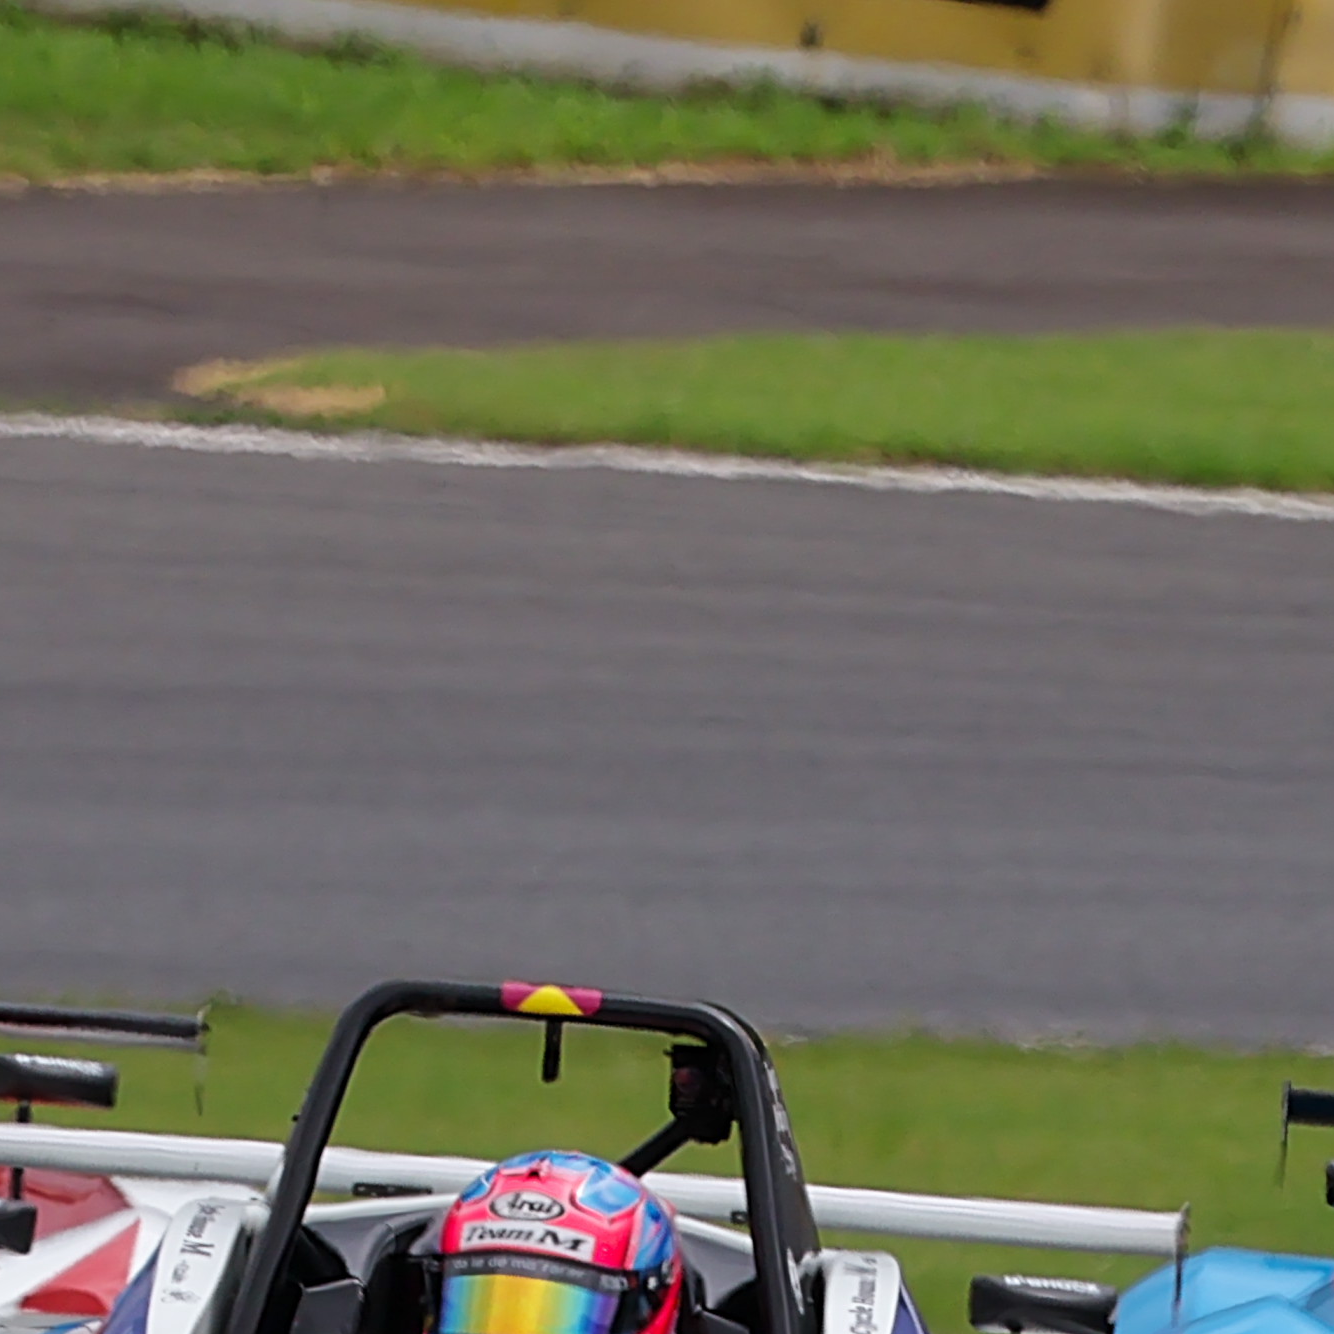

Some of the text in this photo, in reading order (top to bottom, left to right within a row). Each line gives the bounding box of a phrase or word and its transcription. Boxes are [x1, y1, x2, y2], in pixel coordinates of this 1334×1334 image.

[508, 1193, 554, 1214] Arai
[465, 1224, 589, 1252] Team M
